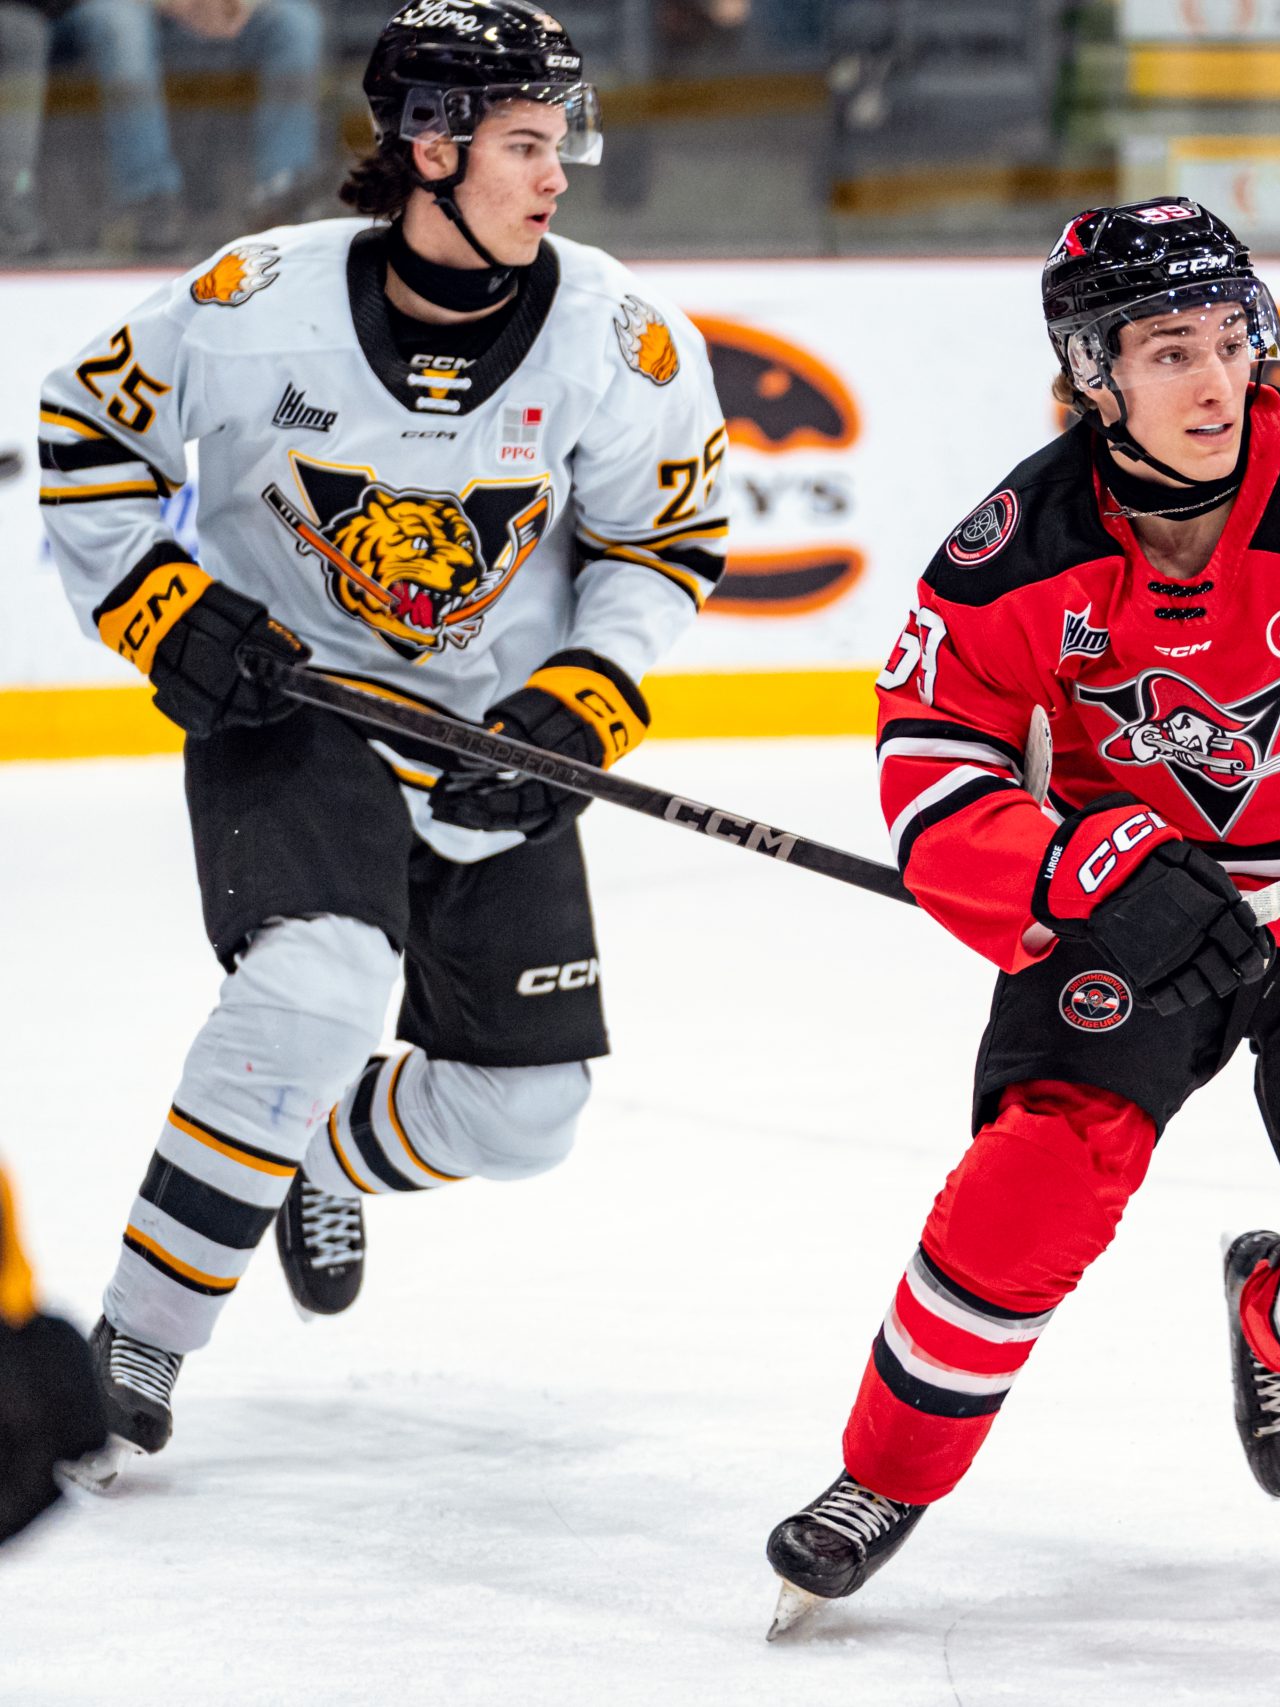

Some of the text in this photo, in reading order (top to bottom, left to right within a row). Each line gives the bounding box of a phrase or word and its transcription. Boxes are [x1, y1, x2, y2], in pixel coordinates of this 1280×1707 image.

[546, 54, 580, 68] CCM
[1141, 204, 1193, 224] 59
[1168, 254, 1228, 275] CCM
[76, 324, 173, 435] 25
[401, 430, 458, 441] CCM
[501, 446, 536, 460] PPG
[664, 796, 800, 863] CCM
[1044, 844, 1063, 880] LAROSE
[1068, 973, 1128, 1001] DRUMMONDVILLE
[1063, 1005, 1122, 1029] VOLTIGEURS
